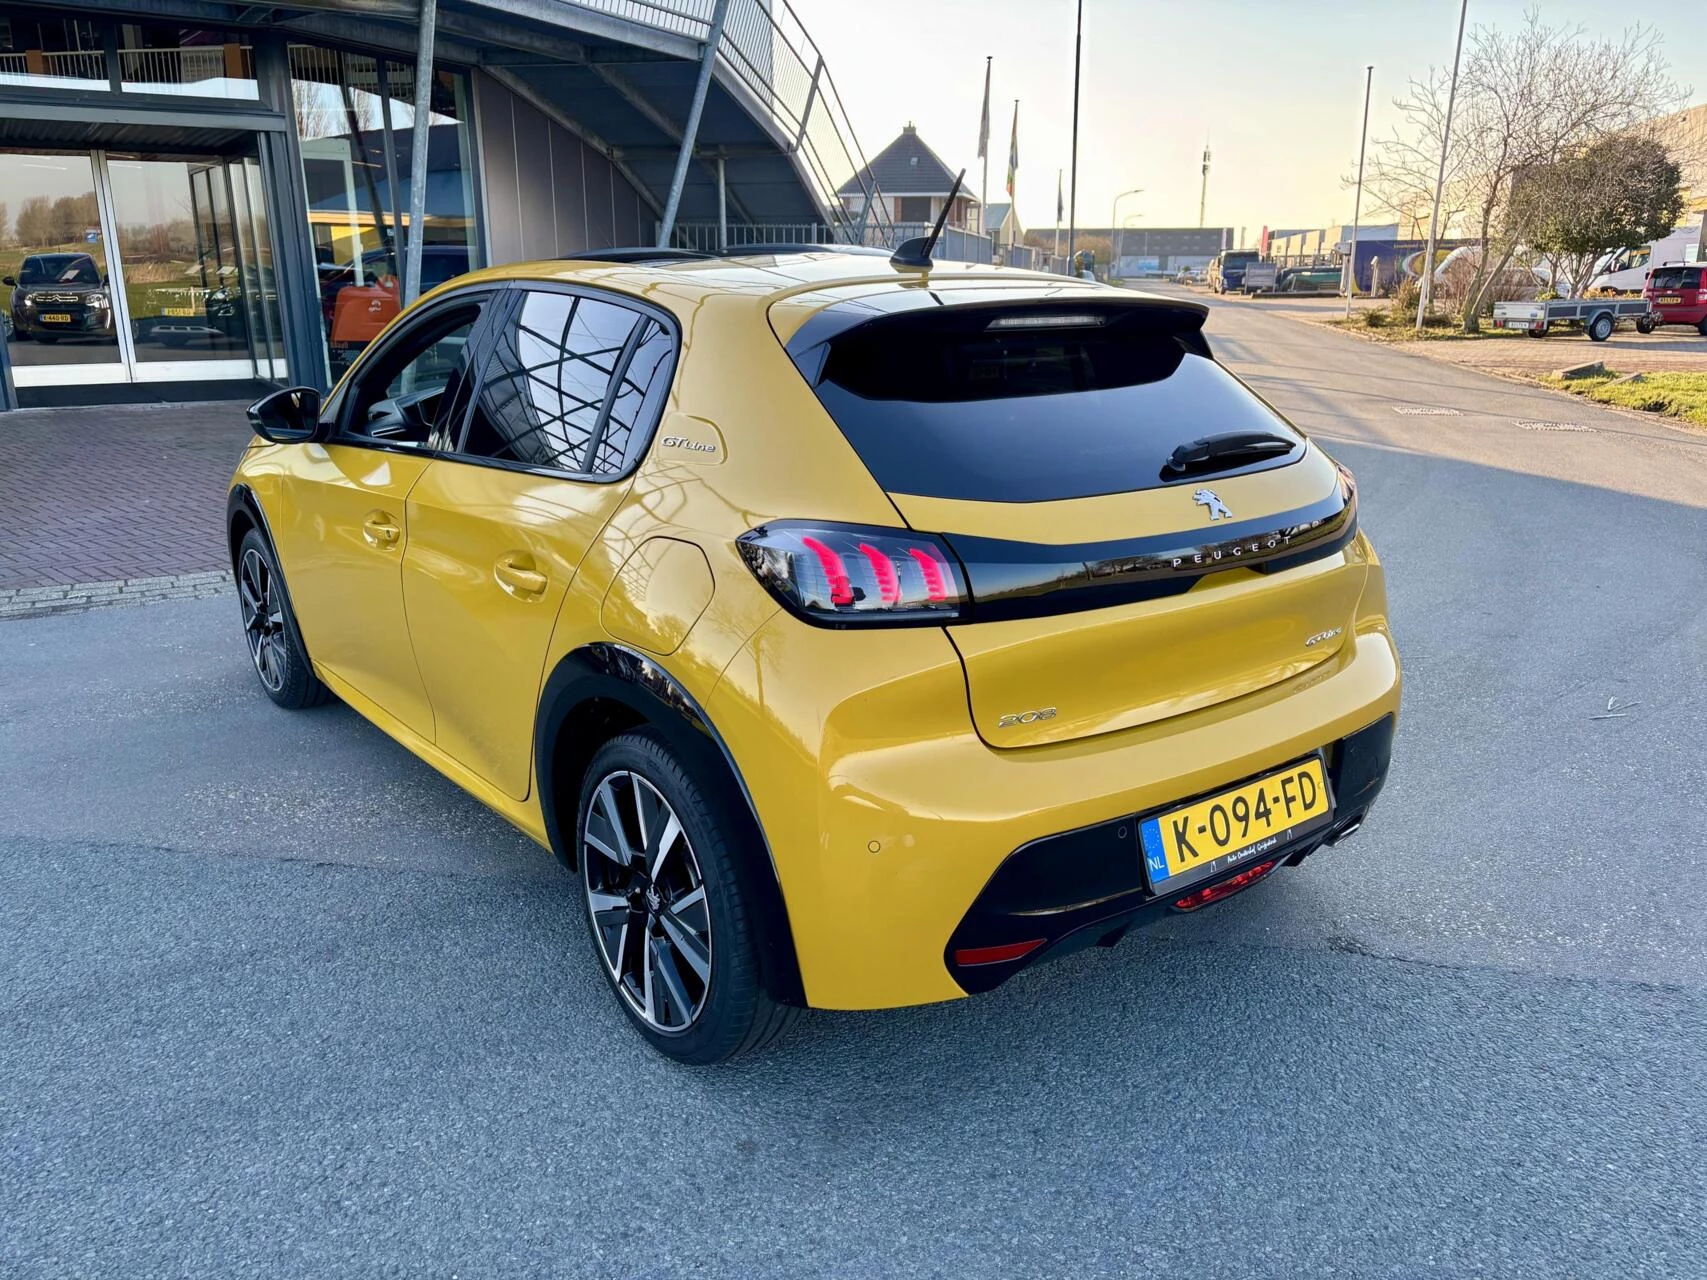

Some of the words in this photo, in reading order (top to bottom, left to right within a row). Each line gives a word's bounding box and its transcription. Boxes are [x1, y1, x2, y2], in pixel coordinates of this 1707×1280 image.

[1173, 535, 1291, 567] PEUGEOT
[999, 706, 1057, 728] 208
[1172, 771, 1317, 864] K-094-FD
[1149, 858, 1164, 873] NL
